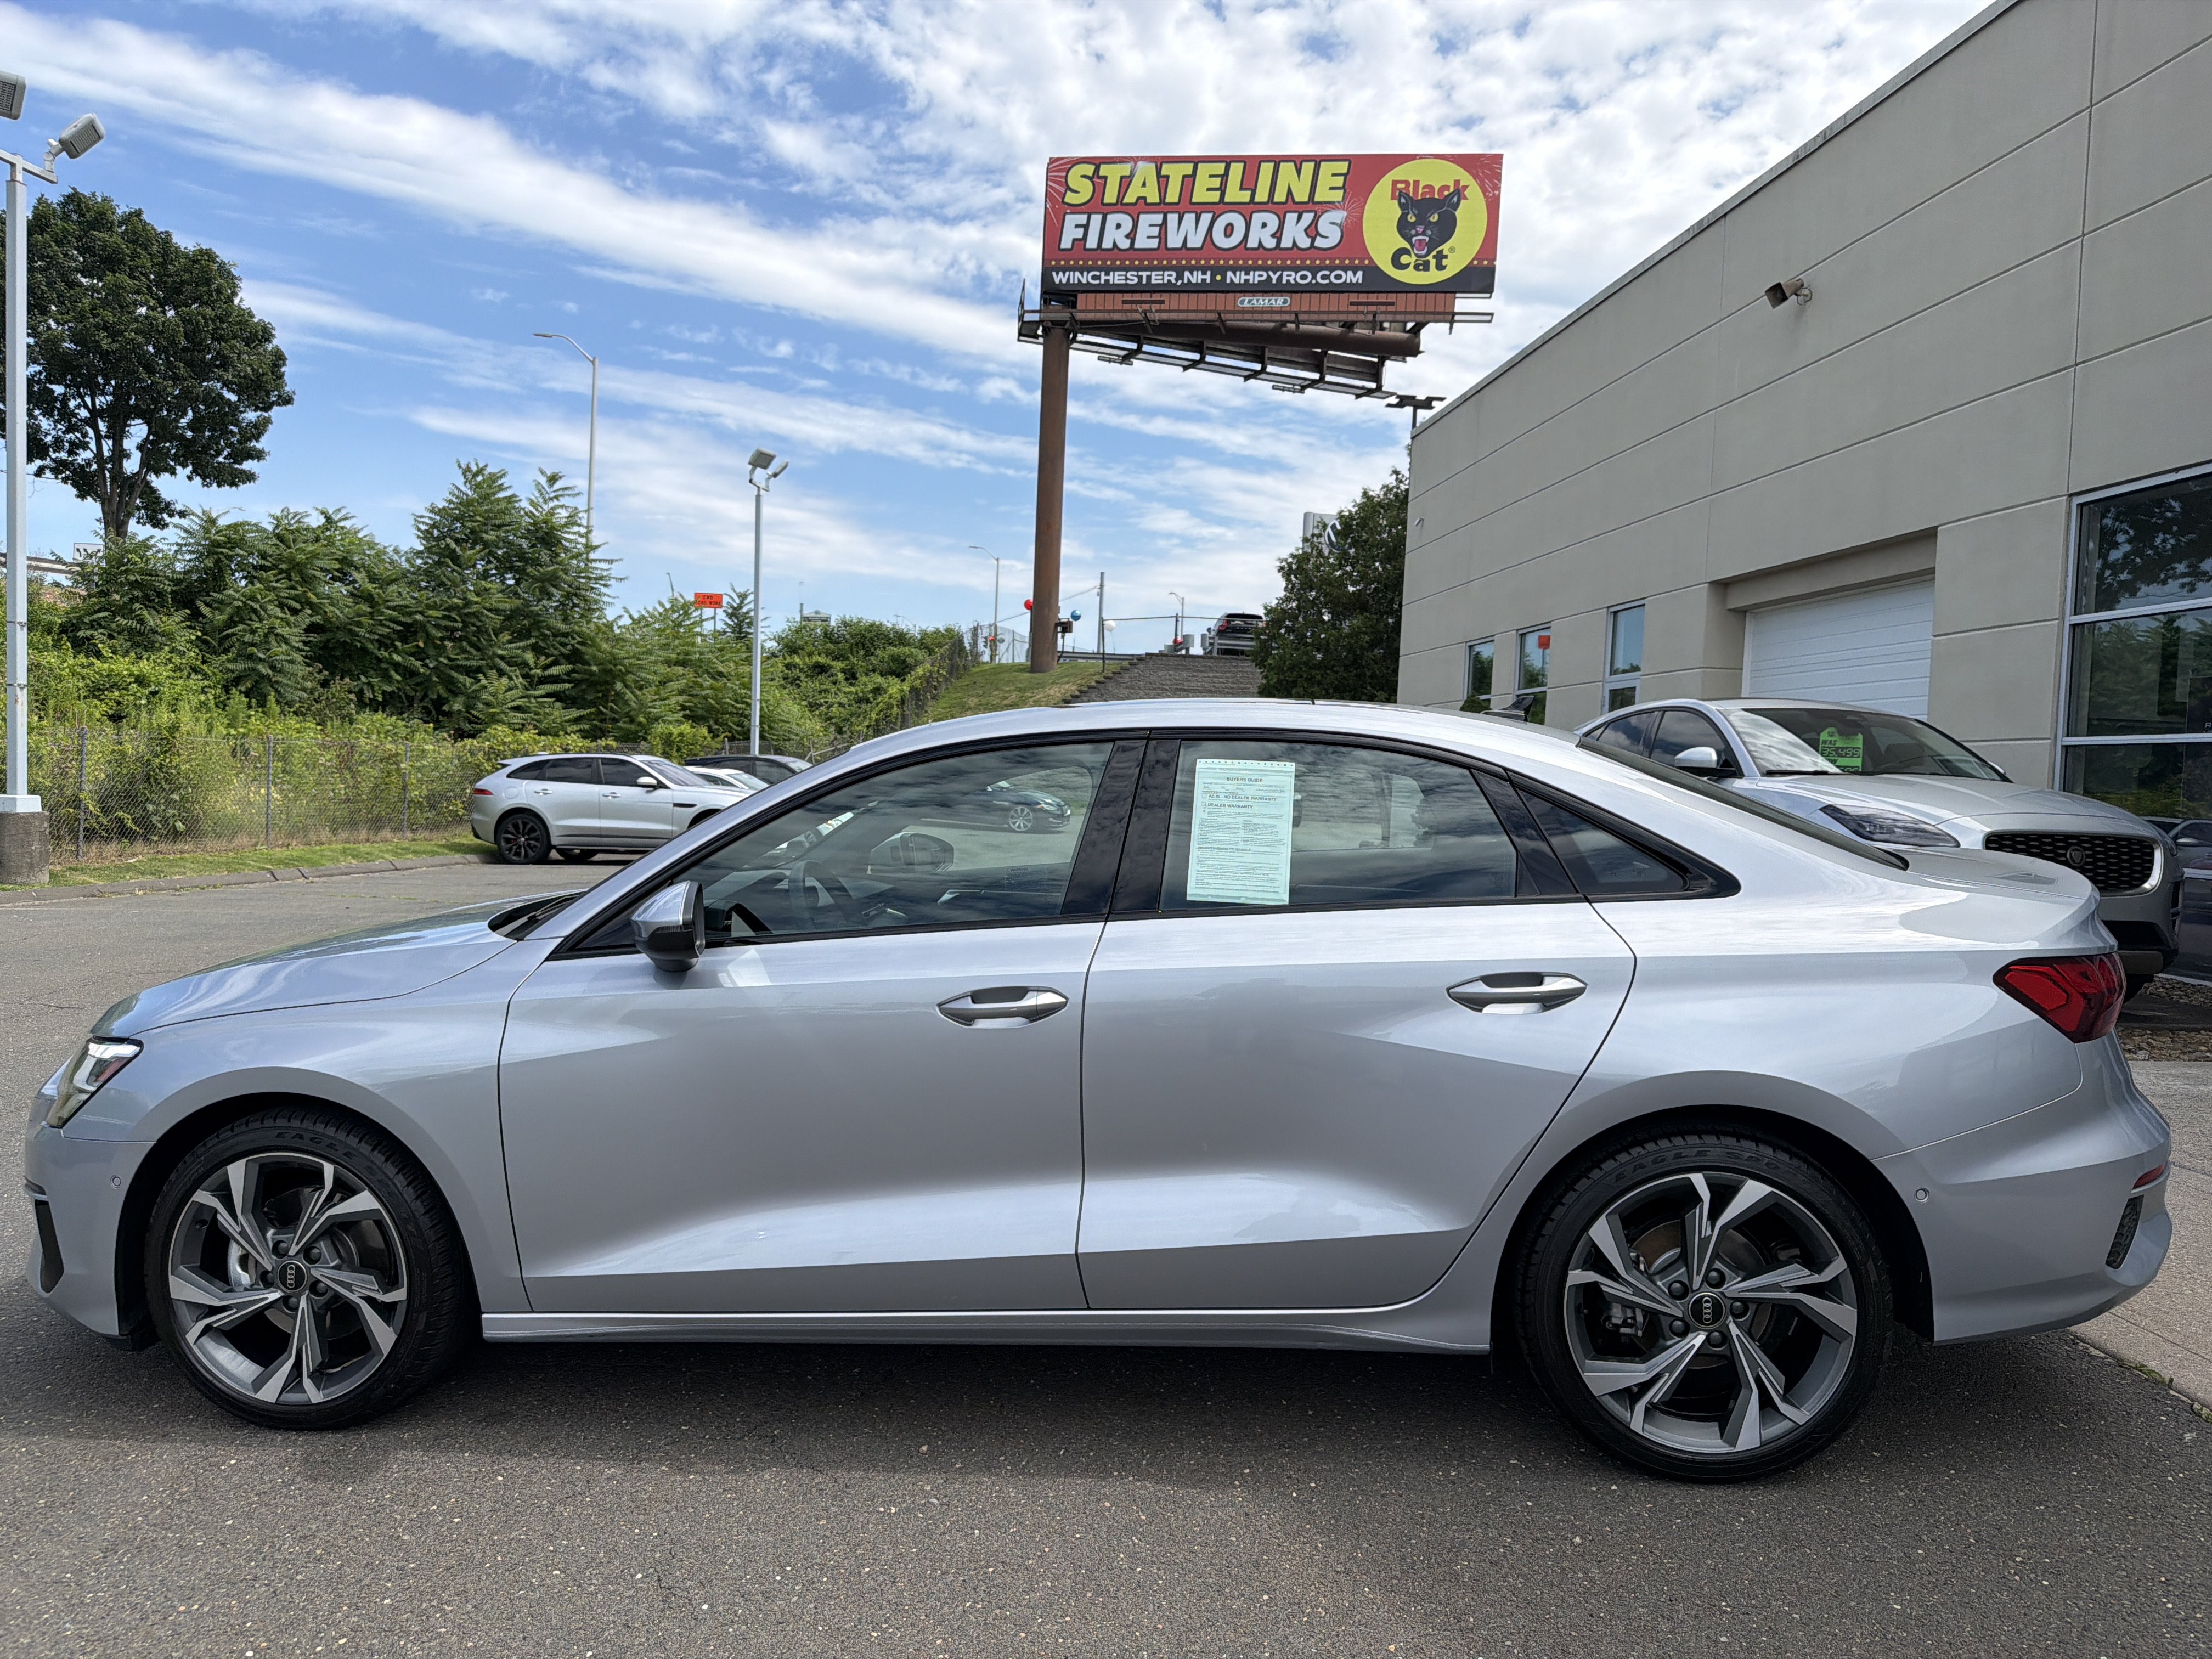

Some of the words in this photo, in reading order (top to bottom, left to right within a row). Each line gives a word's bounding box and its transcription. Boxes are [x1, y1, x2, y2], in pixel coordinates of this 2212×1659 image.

[1062, 161, 1350, 206] STATELINE
[1390, 179, 1470, 200] Black
[1059, 211, 1347, 250] FIREWORKS
[1391, 247, 1448, 272] Cat
[1226, 270, 1363, 284] NHPYRO.COM
[275, 1131, 359, 1160] EAGLE
[1615, 1149, 1711, 1183] EAGLE
